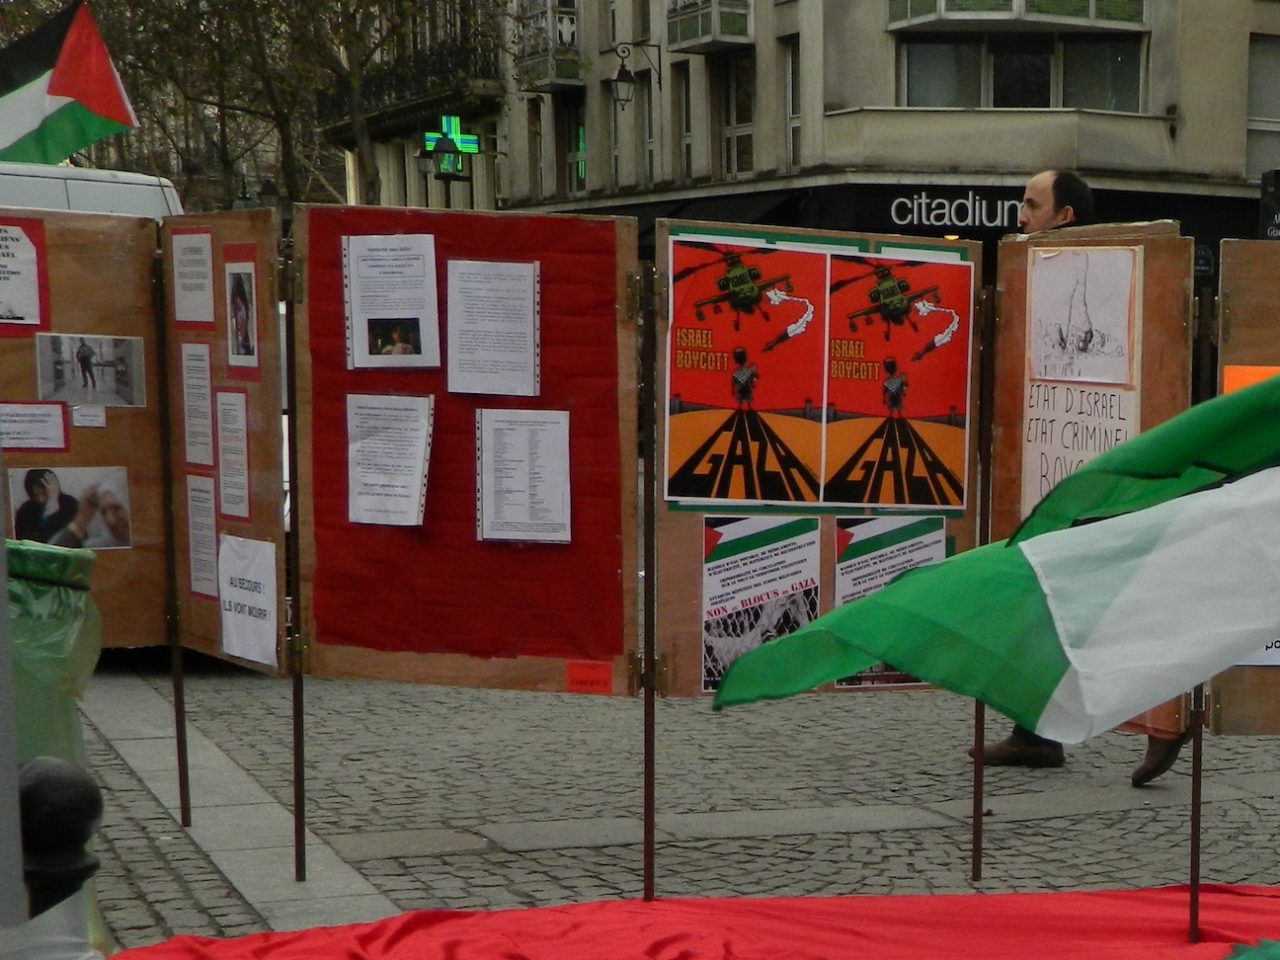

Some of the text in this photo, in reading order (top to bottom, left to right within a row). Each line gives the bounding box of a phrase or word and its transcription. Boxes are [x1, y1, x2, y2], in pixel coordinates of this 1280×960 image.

[677, 328, 713, 348] ISRAEL
[831, 339, 865, 358] ISRAEL
[676, 350, 729, 371] BOYCOTT
[831, 361, 881, 381] BOYCOTT
[668, 409, 820, 500] GAZA
[824, 415, 964, 506] GAZA
[706, 605, 728, 619] NON
[740, 589, 780, 608] BLOCUS
[790, 577, 816, 593] GAZA
